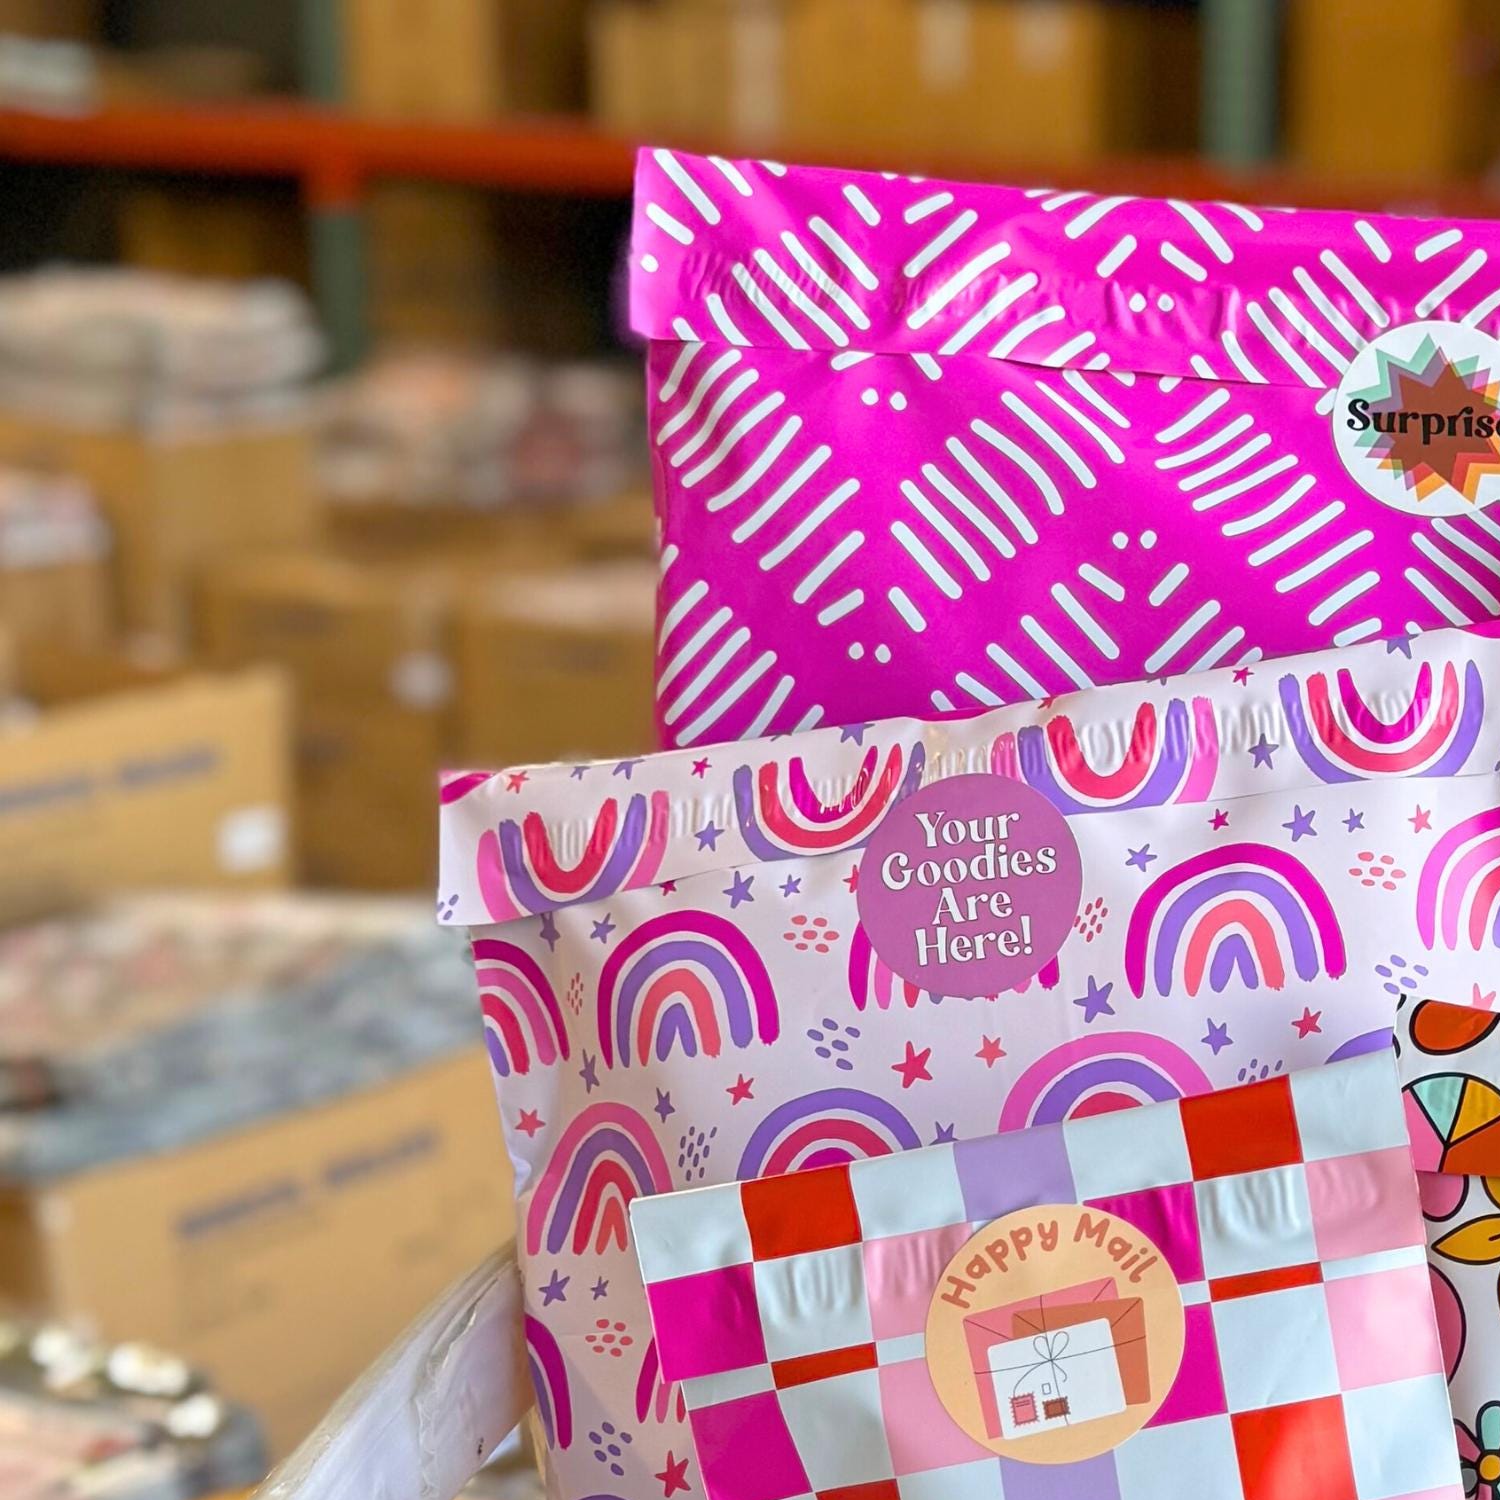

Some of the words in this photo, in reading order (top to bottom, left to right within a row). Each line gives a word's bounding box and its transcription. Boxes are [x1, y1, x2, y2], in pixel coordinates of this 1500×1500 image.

[915, 811, 1020, 847] Your
[881, 843, 1057, 890] Goodies
[932, 887, 1013, 925] Are
[914, 915, 1033, 966] Here!
[941, 1220, 1058, 1308] Happy
[1073, 1213, 1158, 1283] Mail
